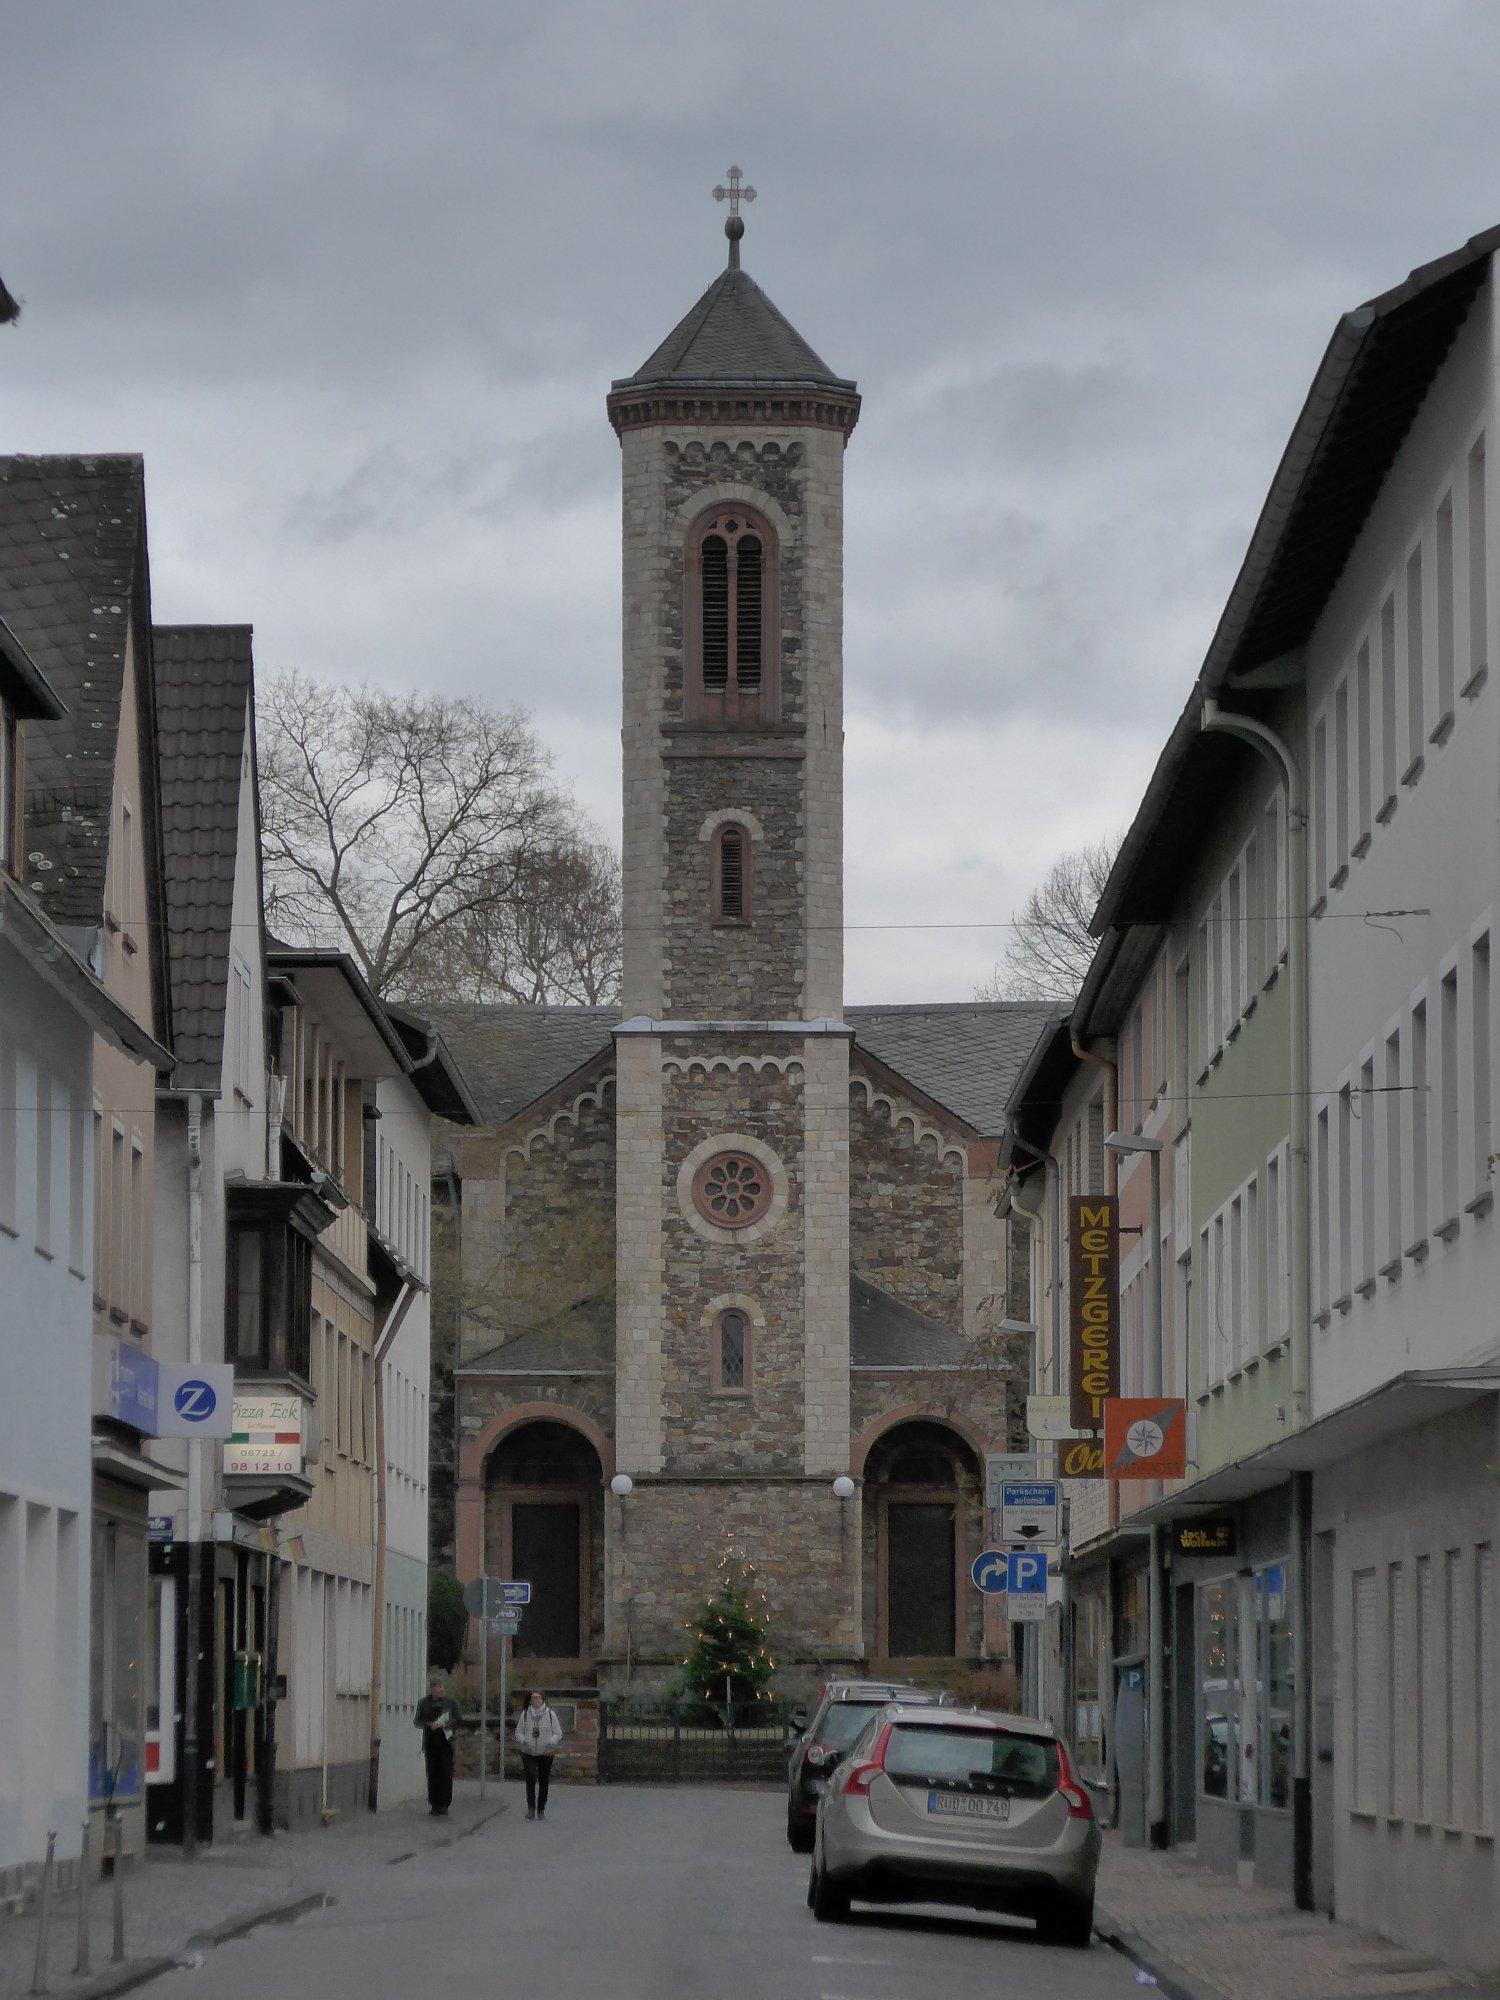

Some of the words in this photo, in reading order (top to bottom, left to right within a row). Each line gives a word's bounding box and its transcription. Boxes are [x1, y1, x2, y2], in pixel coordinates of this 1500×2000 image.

[1079, 1206, 1110, 1418] METZGEREI
[179, 1387, 210, 1416] Z
[269, 1399, 299, 1421] Eck
[230, 1462, 248, 1471] 98
[254, 1462, 270, 1471] 12
[278, 1462, 292, 1471] 10
[1014, 1496, 1046, 1505] automat
[1180, 1529, 1207, 1539] Jack
[1016, 1557, 1038, 1589] P
[1129, 1671, 1140, 1687] P
